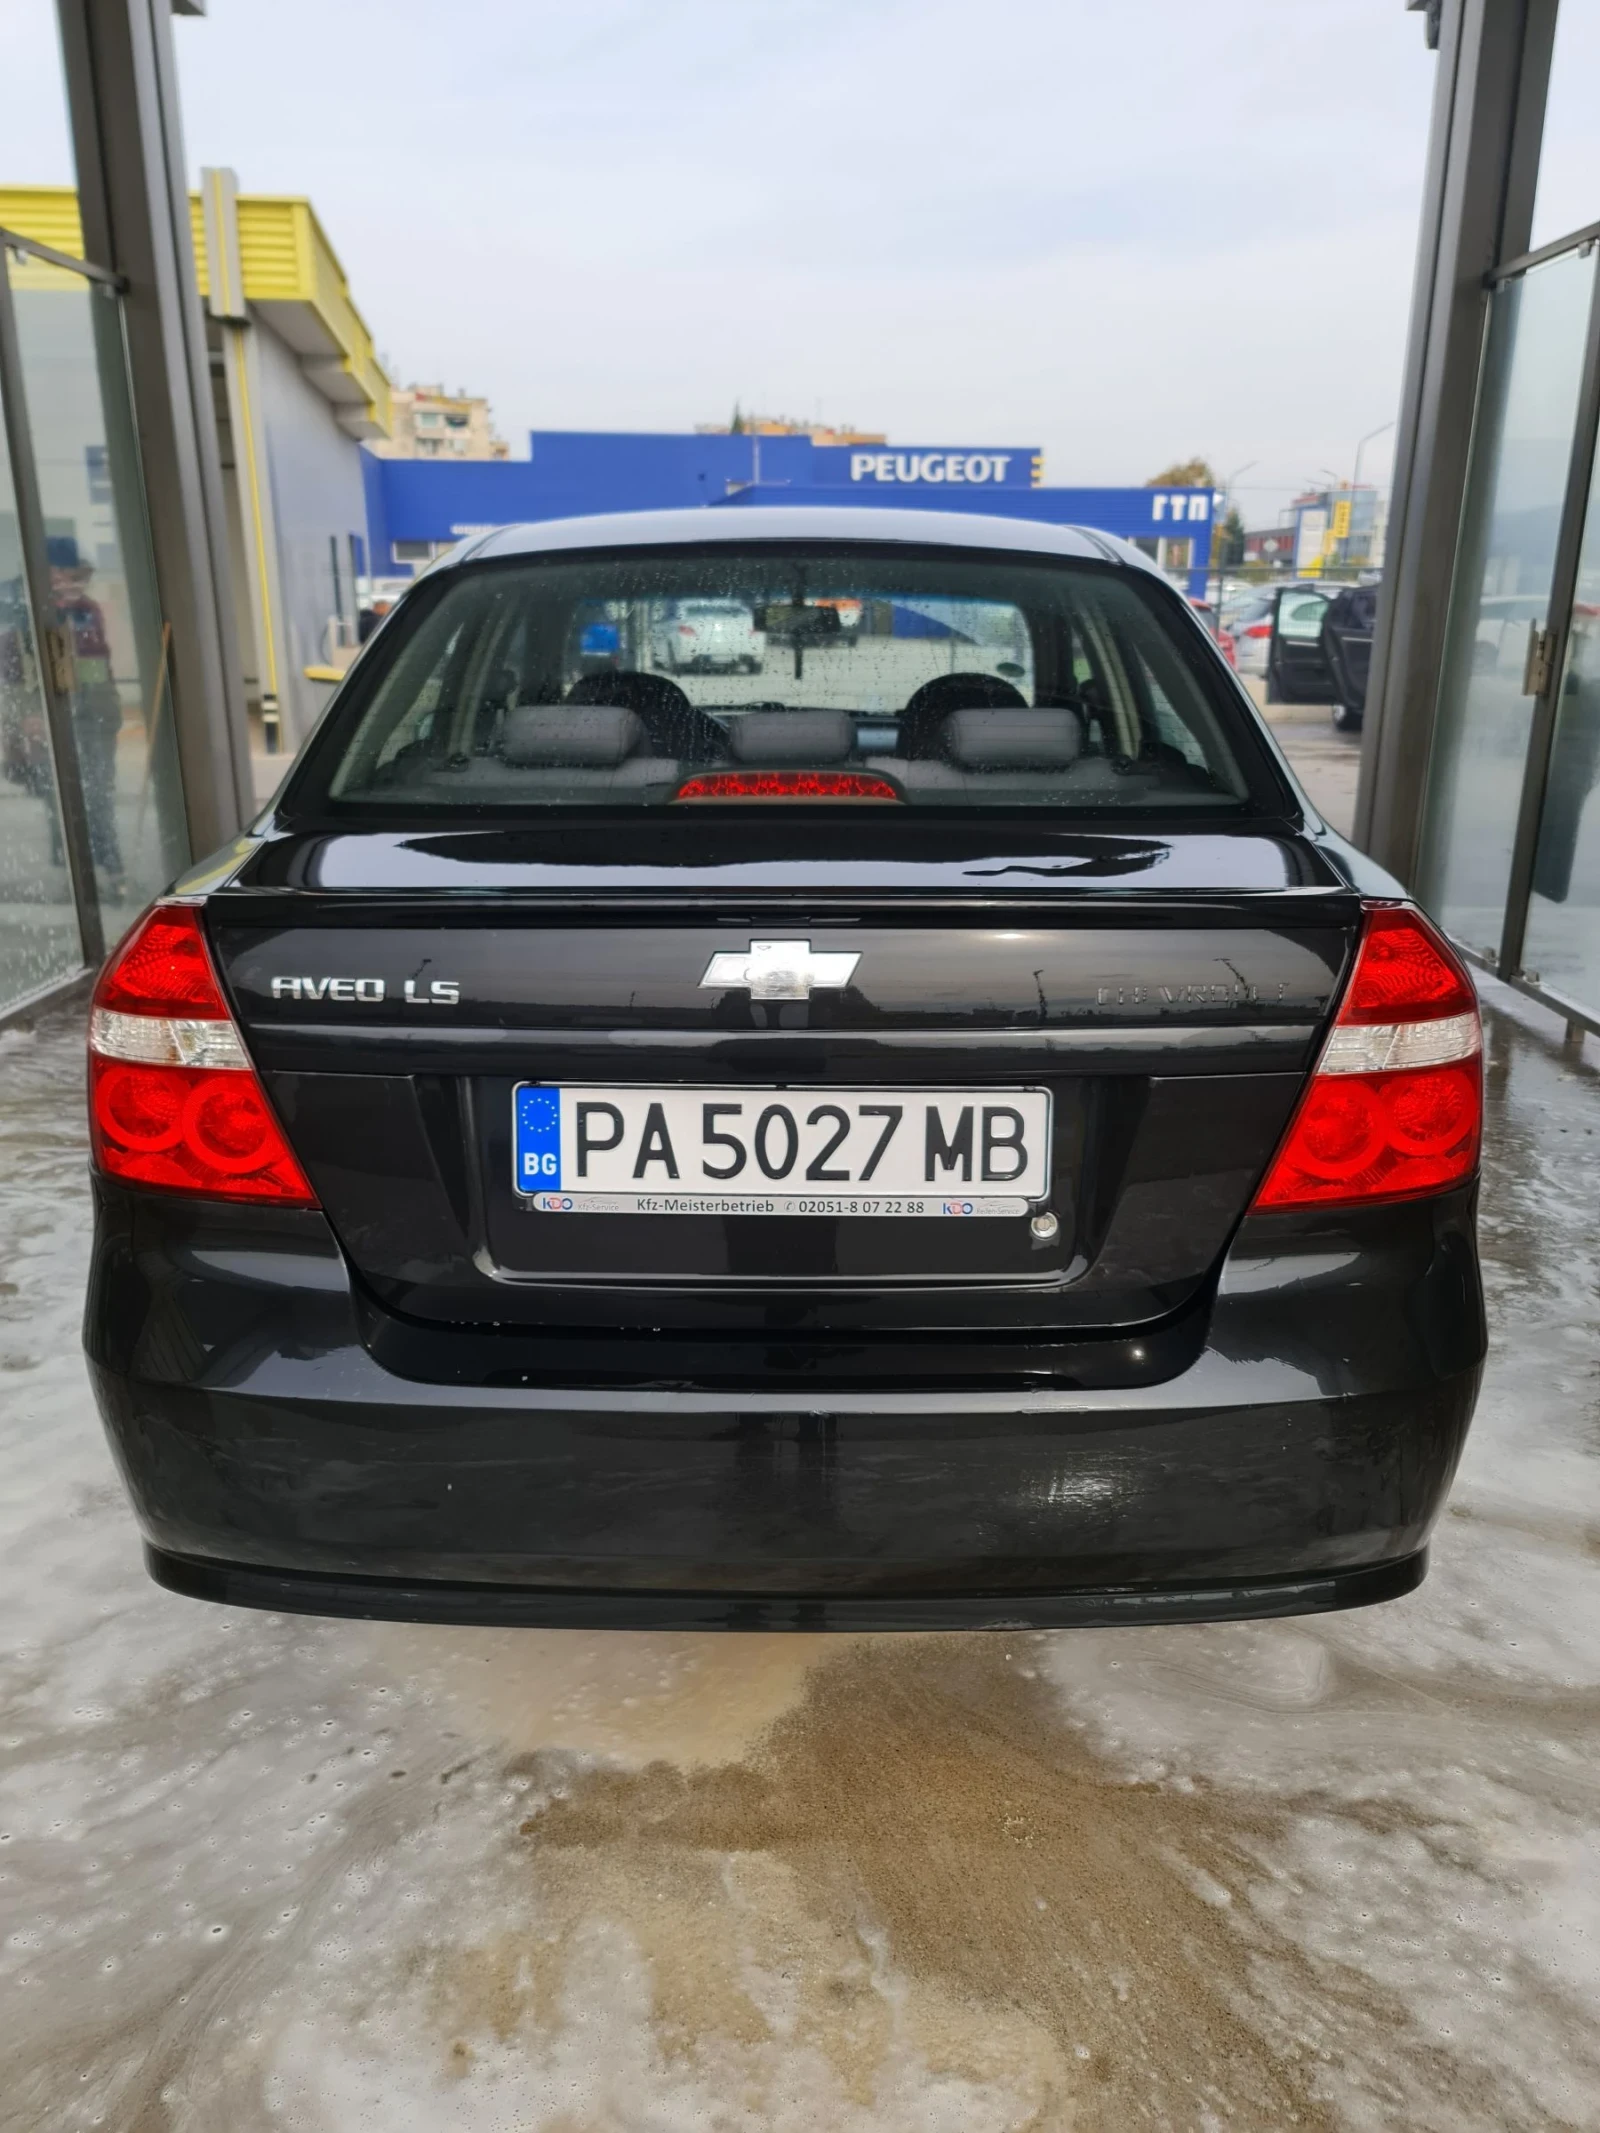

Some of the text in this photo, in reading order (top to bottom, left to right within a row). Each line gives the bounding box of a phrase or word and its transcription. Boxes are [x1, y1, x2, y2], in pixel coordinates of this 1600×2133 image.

[851, 453, 1011, 483] PEUGEOT
[1152, 494, 1209, 521] ГТП
[271, 976, 460, 1004] AVEO LS
[576, 1102, 1029, 1182] PA 5027 MB
[523, 1152, 557, 1176] BG
[637, 1198, 925, 1214] Kfz-Meisterbetrieb 02051-8 07 22 88
